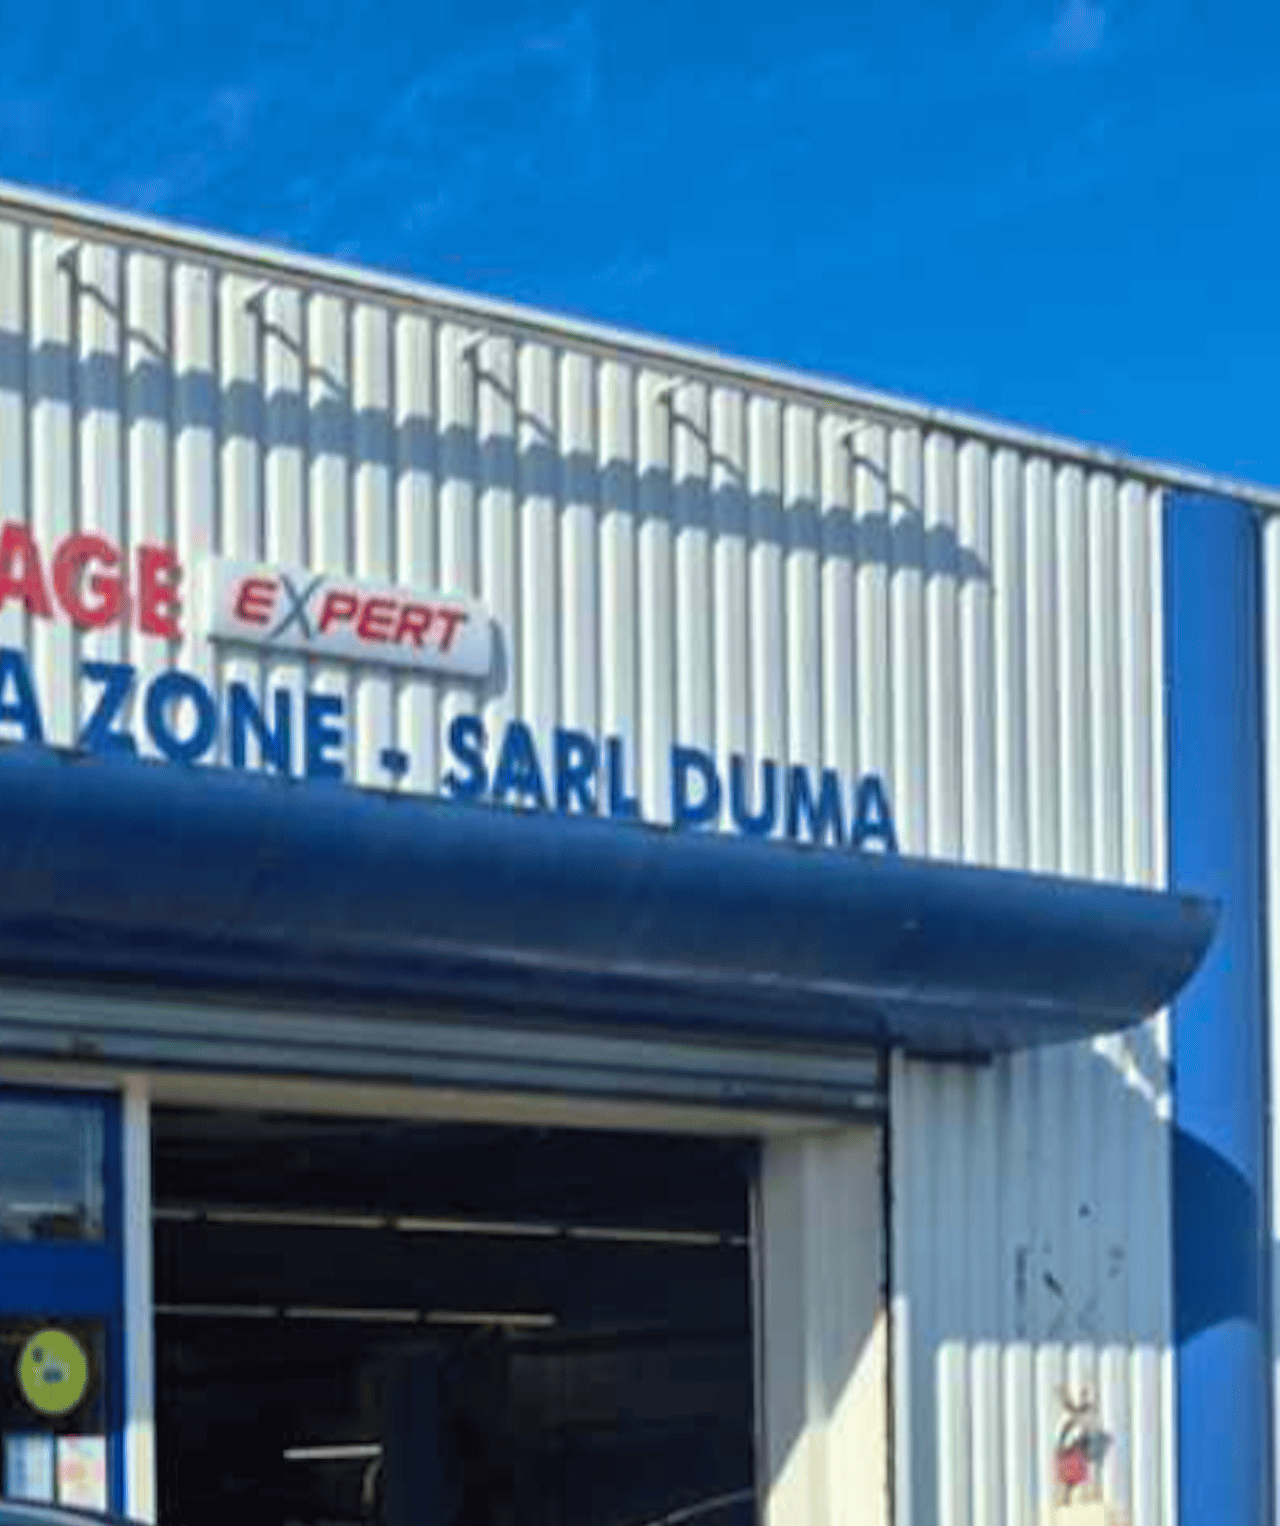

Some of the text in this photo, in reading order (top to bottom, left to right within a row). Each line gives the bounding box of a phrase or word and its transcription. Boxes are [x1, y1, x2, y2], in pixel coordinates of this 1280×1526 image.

[232, 573, 469, 655] EXPERT
[78, 660, 346, 779] ZONE
[441, 714, 640, 820] SARL
[669, 744, 900, 853] DUMA
